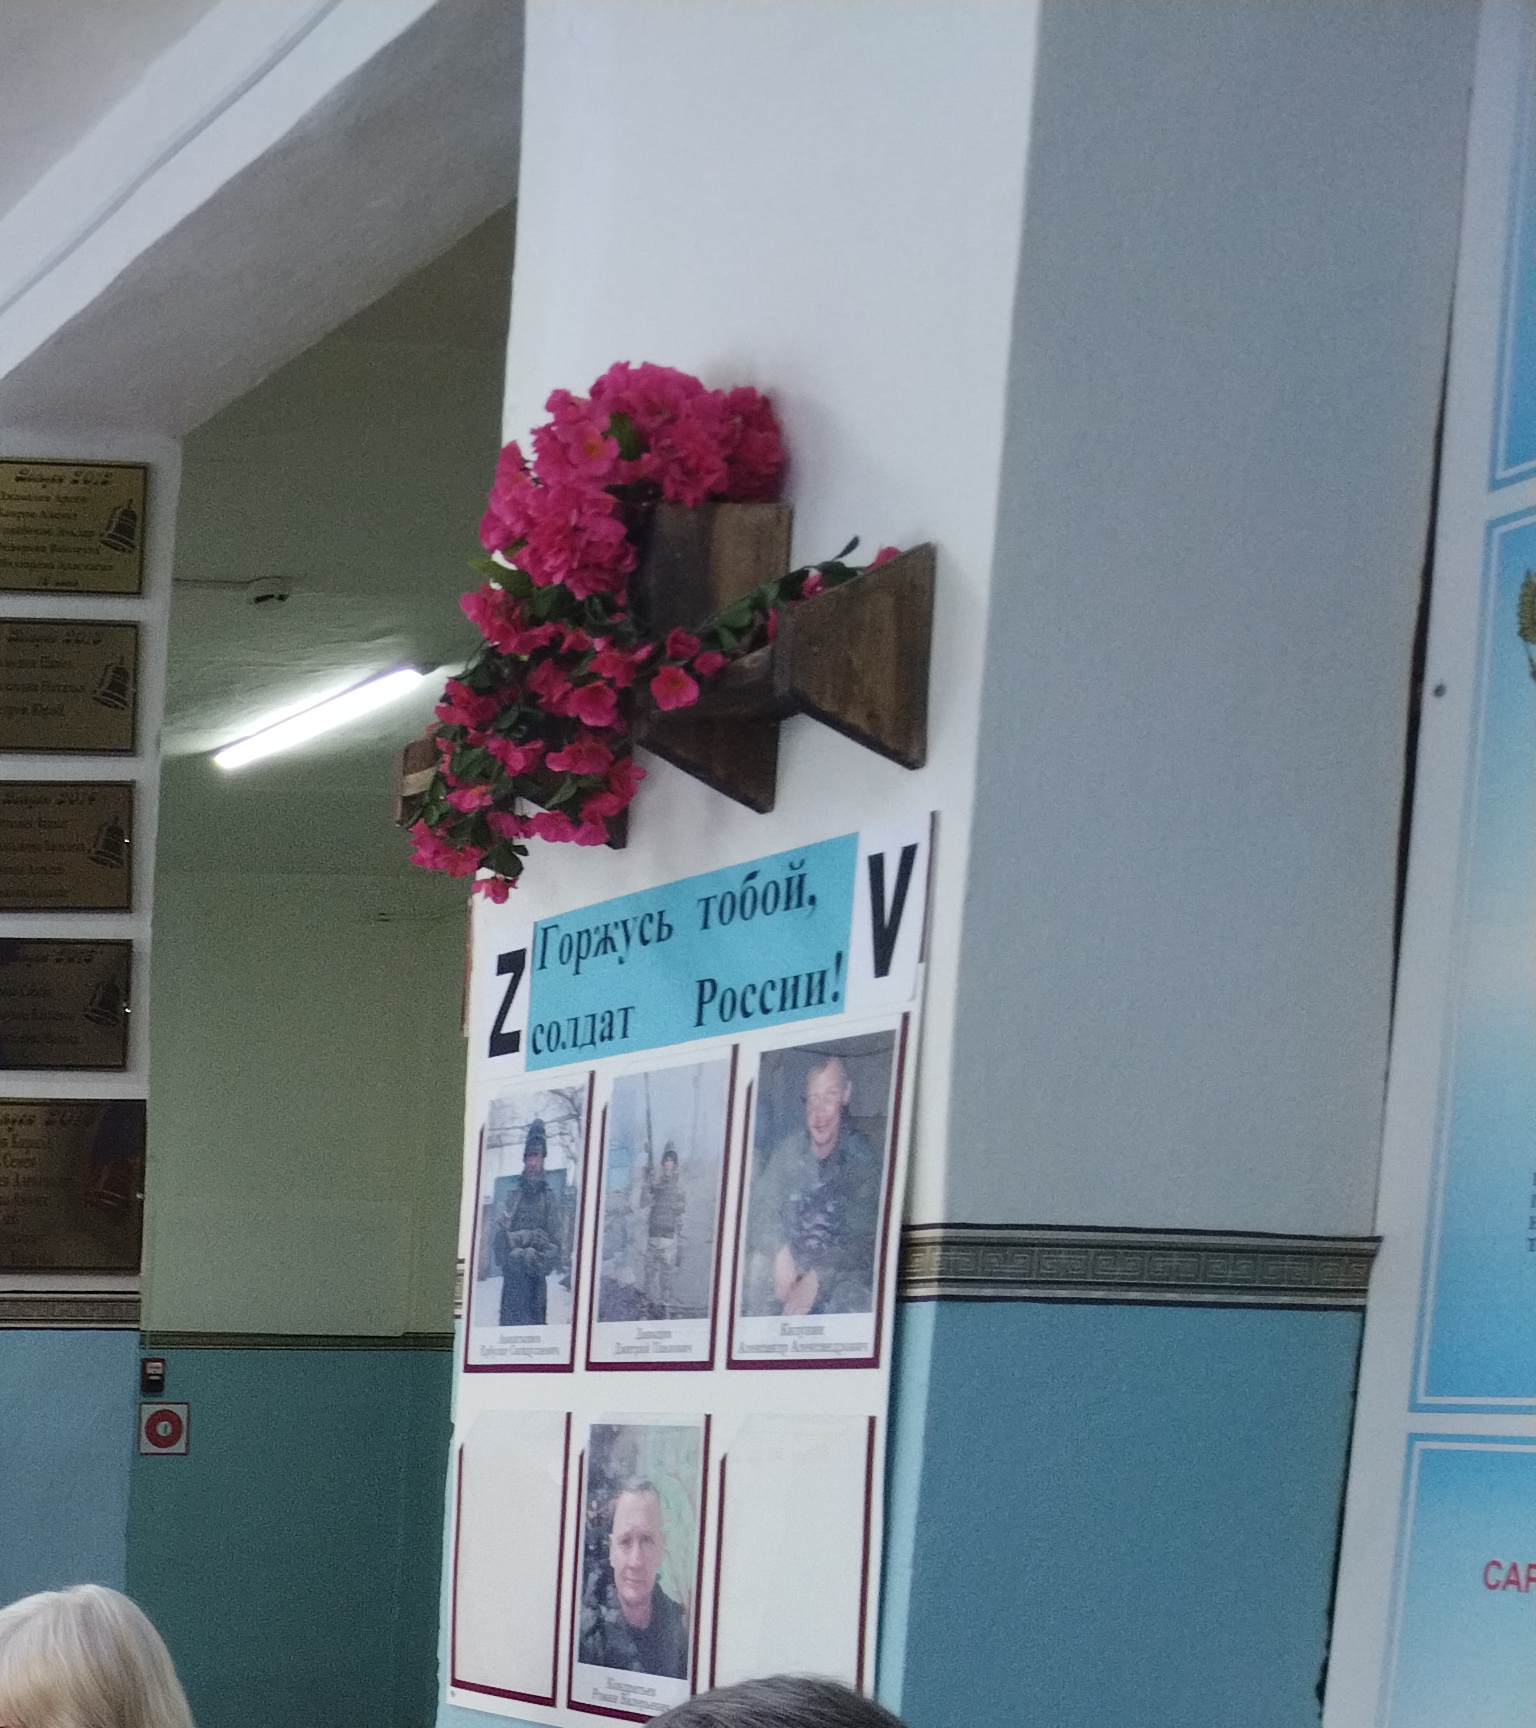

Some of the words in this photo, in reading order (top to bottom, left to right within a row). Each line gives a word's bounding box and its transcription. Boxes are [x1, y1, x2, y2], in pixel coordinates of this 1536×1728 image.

[535, 910, 674, 976] Горжусь
[696, 858, 817, 931] тобой,
[867, 842, 919, 979] V
[487, 948, 527, 1058] Z
[531, 1005, 635, 1055] солдат
[693, 950, 843, 1028] России!
